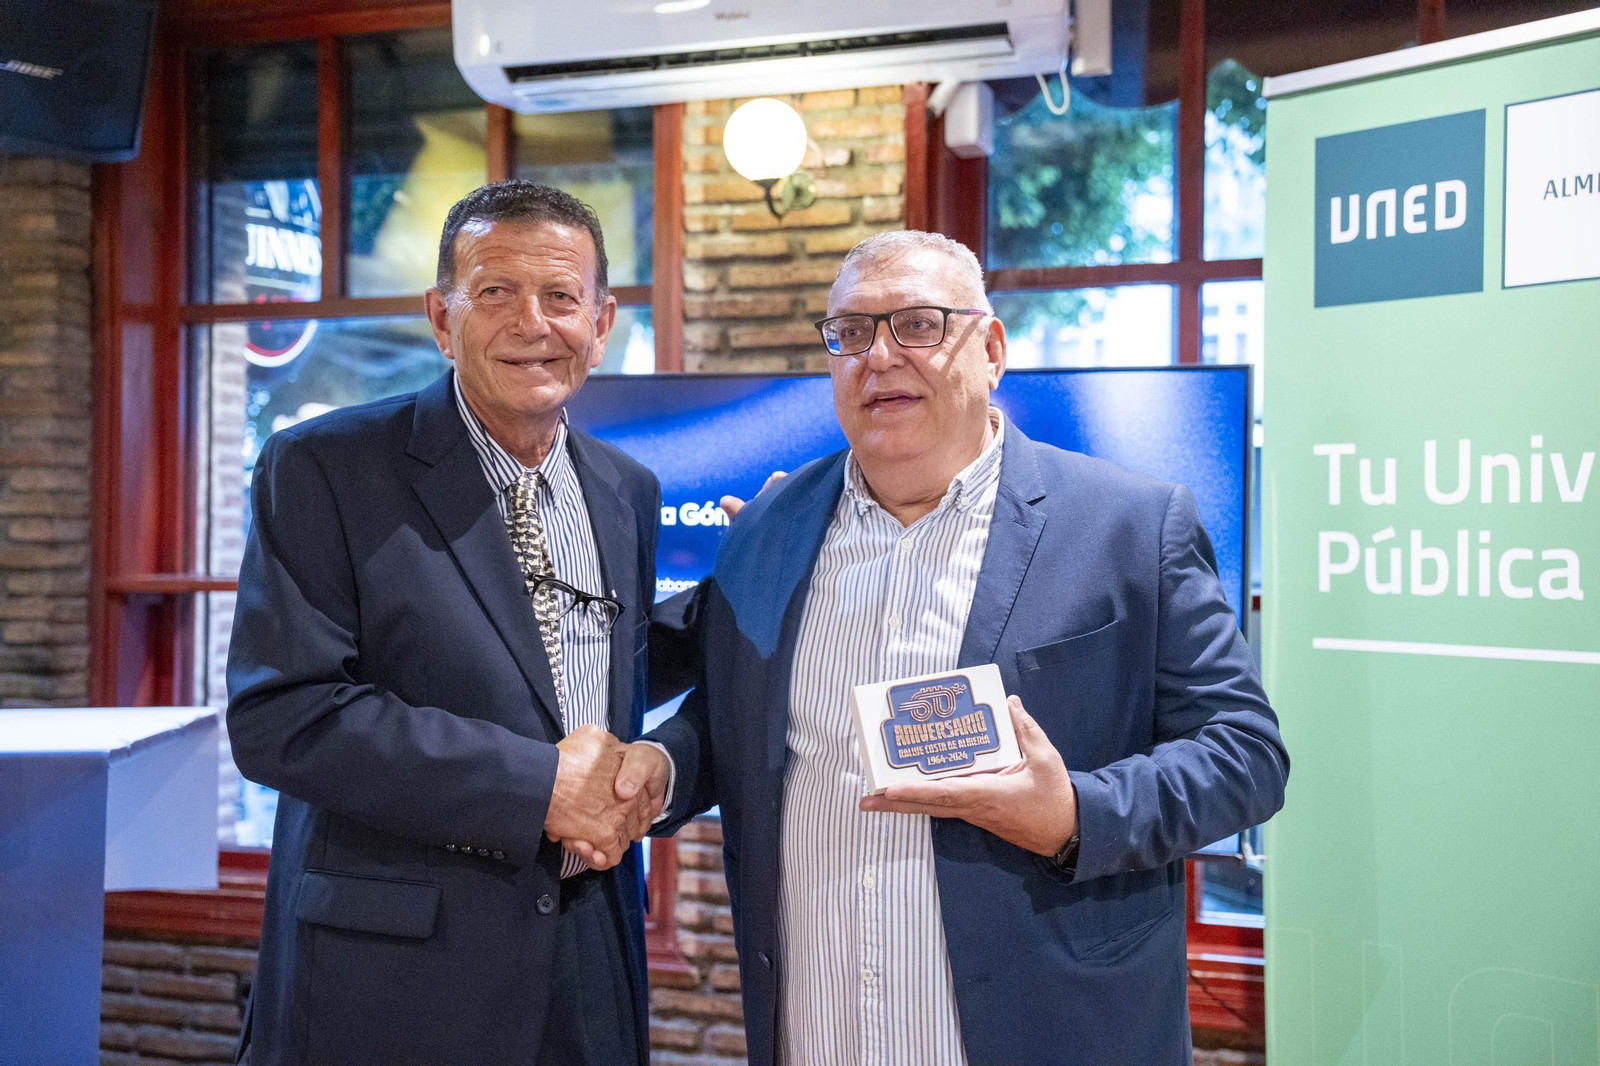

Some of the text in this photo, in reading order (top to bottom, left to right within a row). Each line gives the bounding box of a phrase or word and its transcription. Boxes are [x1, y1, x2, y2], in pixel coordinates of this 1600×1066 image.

[1543, 172, 1600, 200] ALM
[1331, 179, 1467, 244] UNED
[1313, 434, 1596, 505] Tu Univ
[1318, 526, 1584, 601] Pública
[894, 710, 988, 747] ANIVERSARIO
[925, 742, 948, 754] COSTA
[948, 741, 958, 750] DE
[927, 751, 968, 766] 1964-2024
